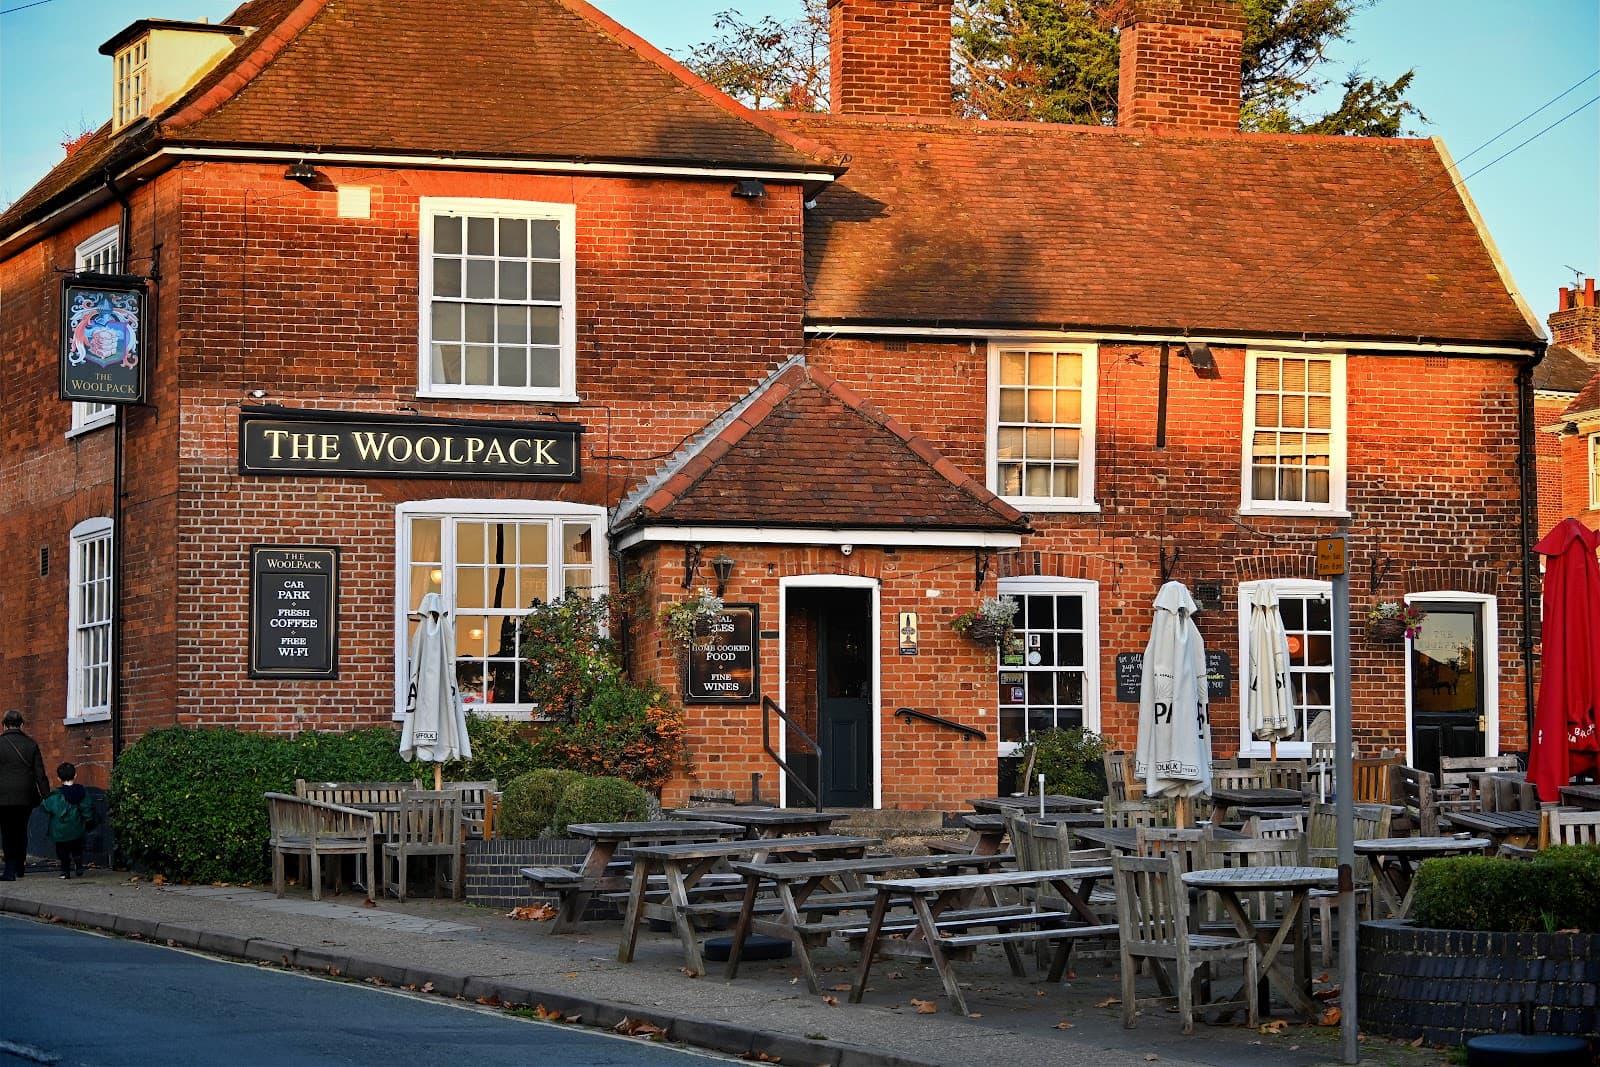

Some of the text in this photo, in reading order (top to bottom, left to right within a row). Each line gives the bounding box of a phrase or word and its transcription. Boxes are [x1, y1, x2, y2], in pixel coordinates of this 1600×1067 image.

[71, 380, 136, 394] WOOLPACK
[264, 430, 560, 465] THE WOOLPACK
[267, 559, 322, 569] WOOLPACK
[277, 591, 310, 600] PARK
[278, 609, 310, 617] FRESH
[270, 619, 318, 628] COFFEE
[281, 637, 307, 645] FREE
[278, 647, 309, 657] WI-FI
[706, 652, 736, 661] FOOD
[704, 682, 739, 691] WINES
